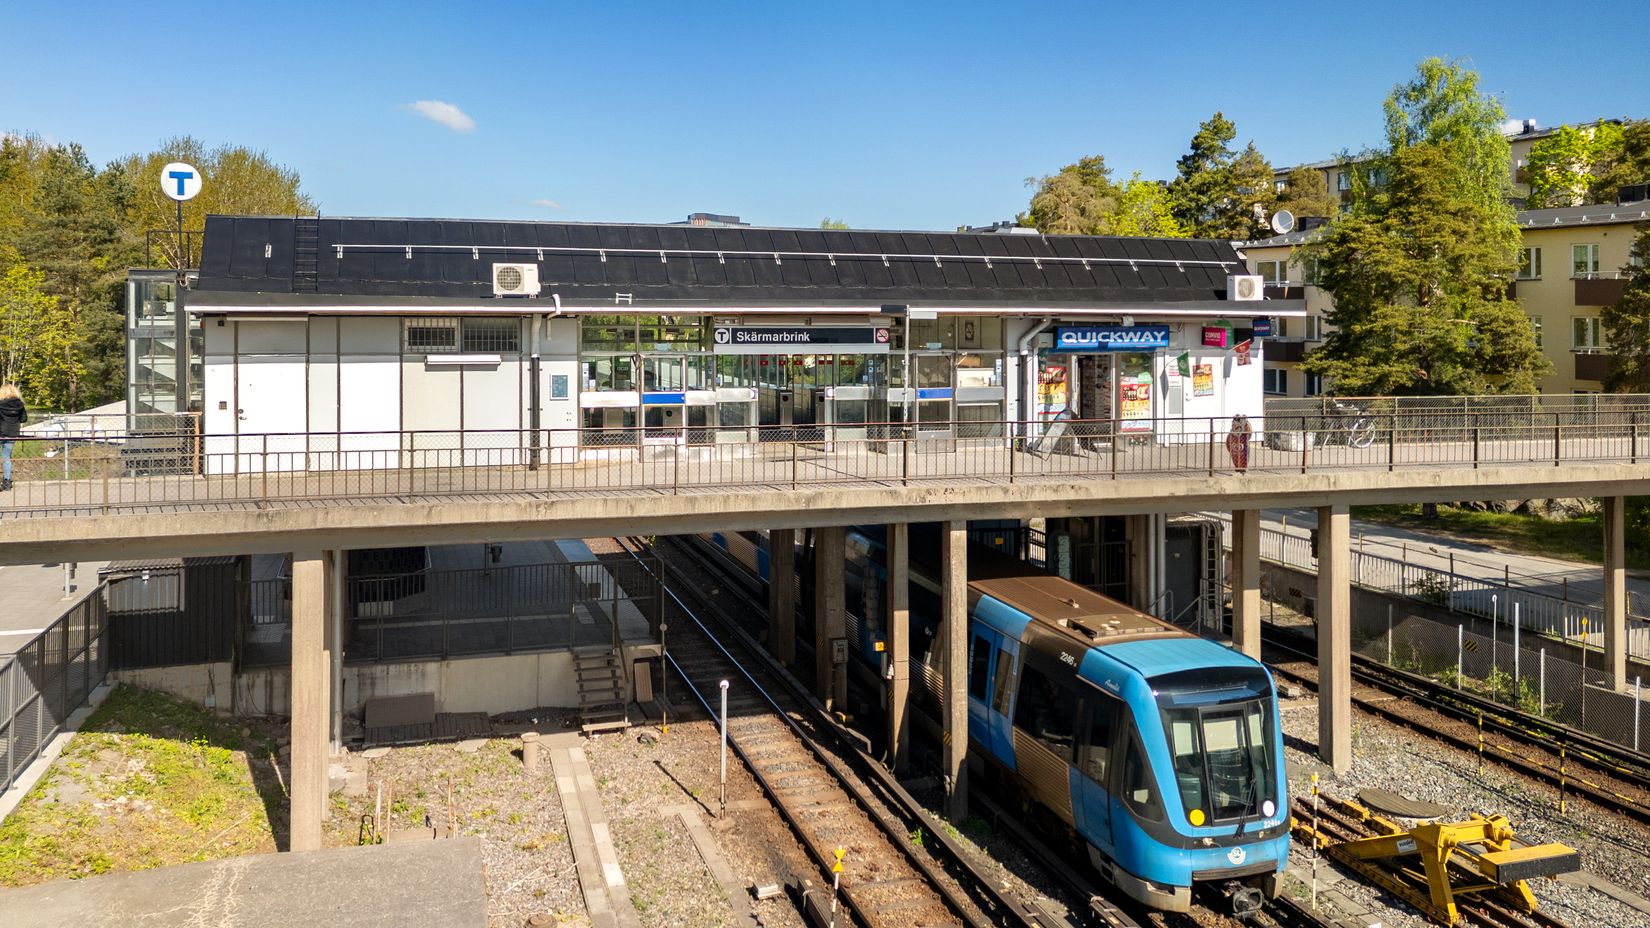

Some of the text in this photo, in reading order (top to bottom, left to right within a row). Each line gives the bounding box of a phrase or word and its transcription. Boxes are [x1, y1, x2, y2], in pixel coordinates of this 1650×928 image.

[169, 171, 193, 196] T
[736, 331, 810, 342] Skärmarbrink
[1061, 331, 1165, 344] QUICKWAY
